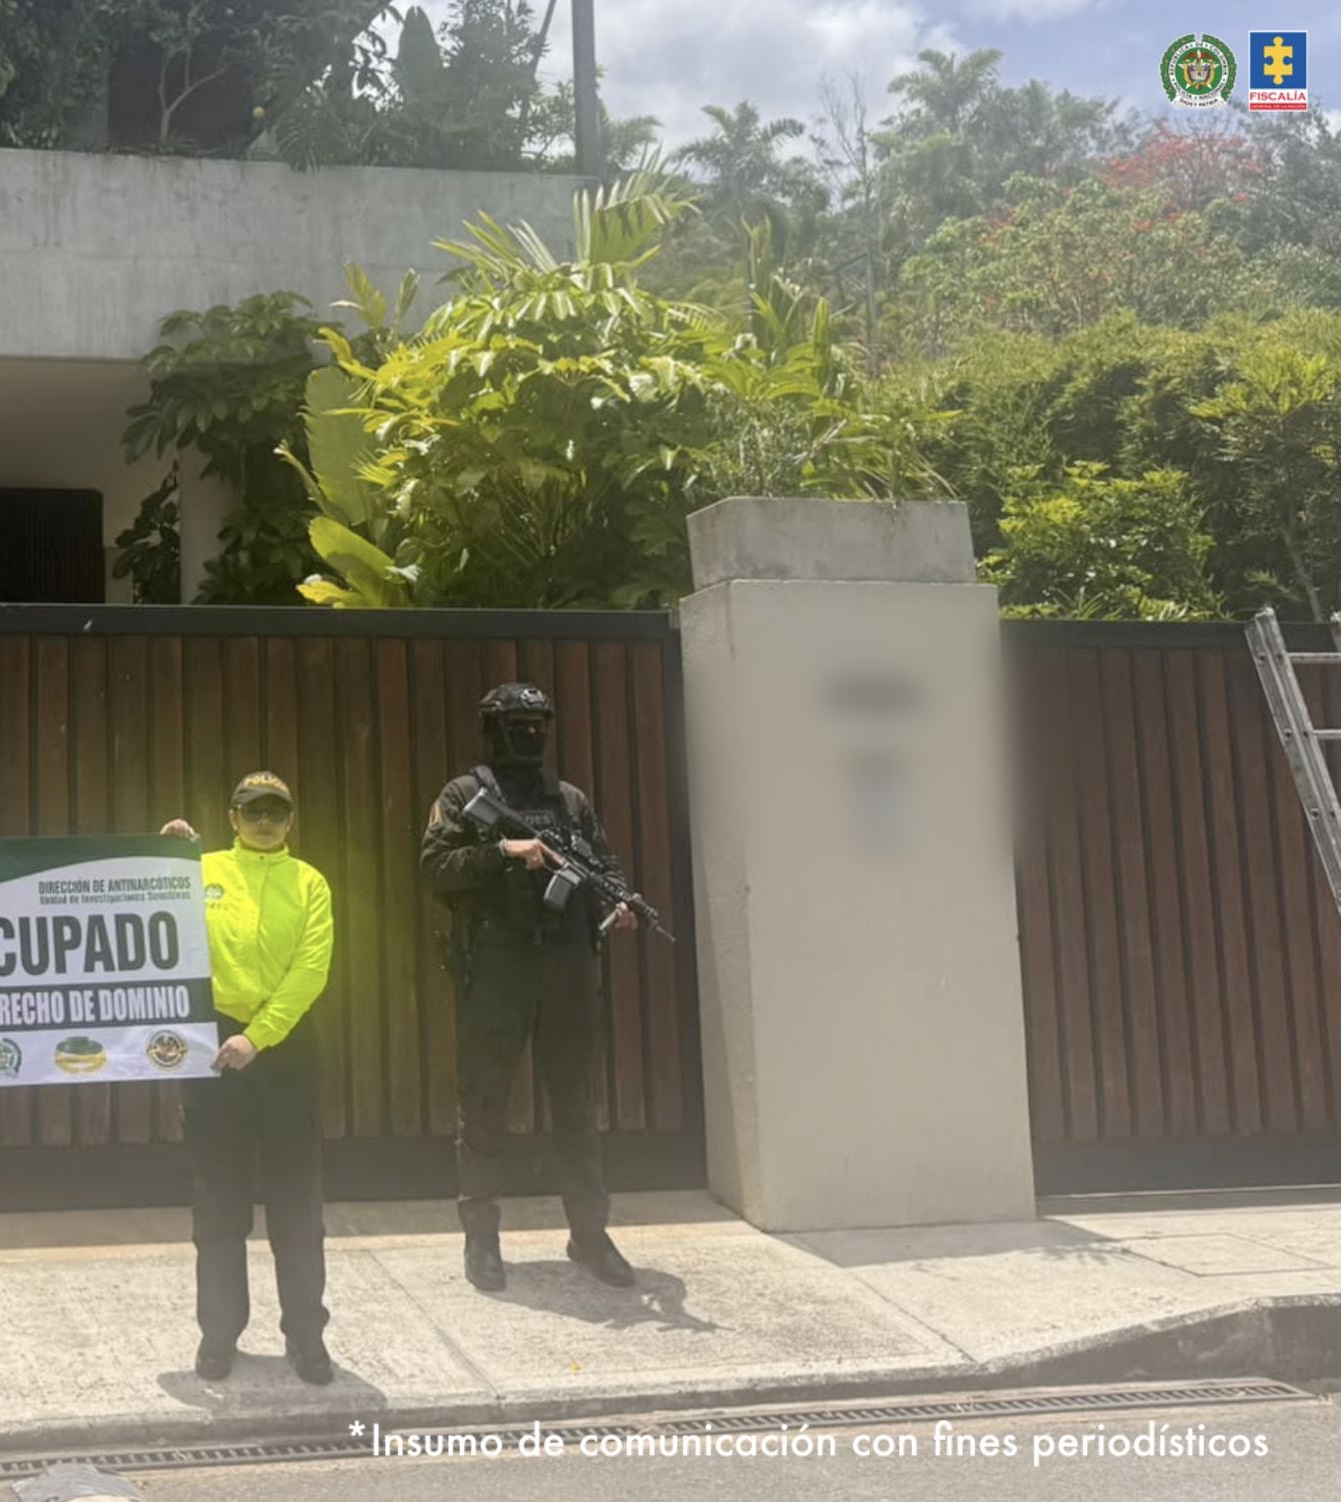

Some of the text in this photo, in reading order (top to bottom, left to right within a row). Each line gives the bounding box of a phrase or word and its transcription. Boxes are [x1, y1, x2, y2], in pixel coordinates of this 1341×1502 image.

[92, 879, 105, 893] DE
[68, 989, 95, 1023] DE
[98, 985, 191, 1022] DOMINIO
